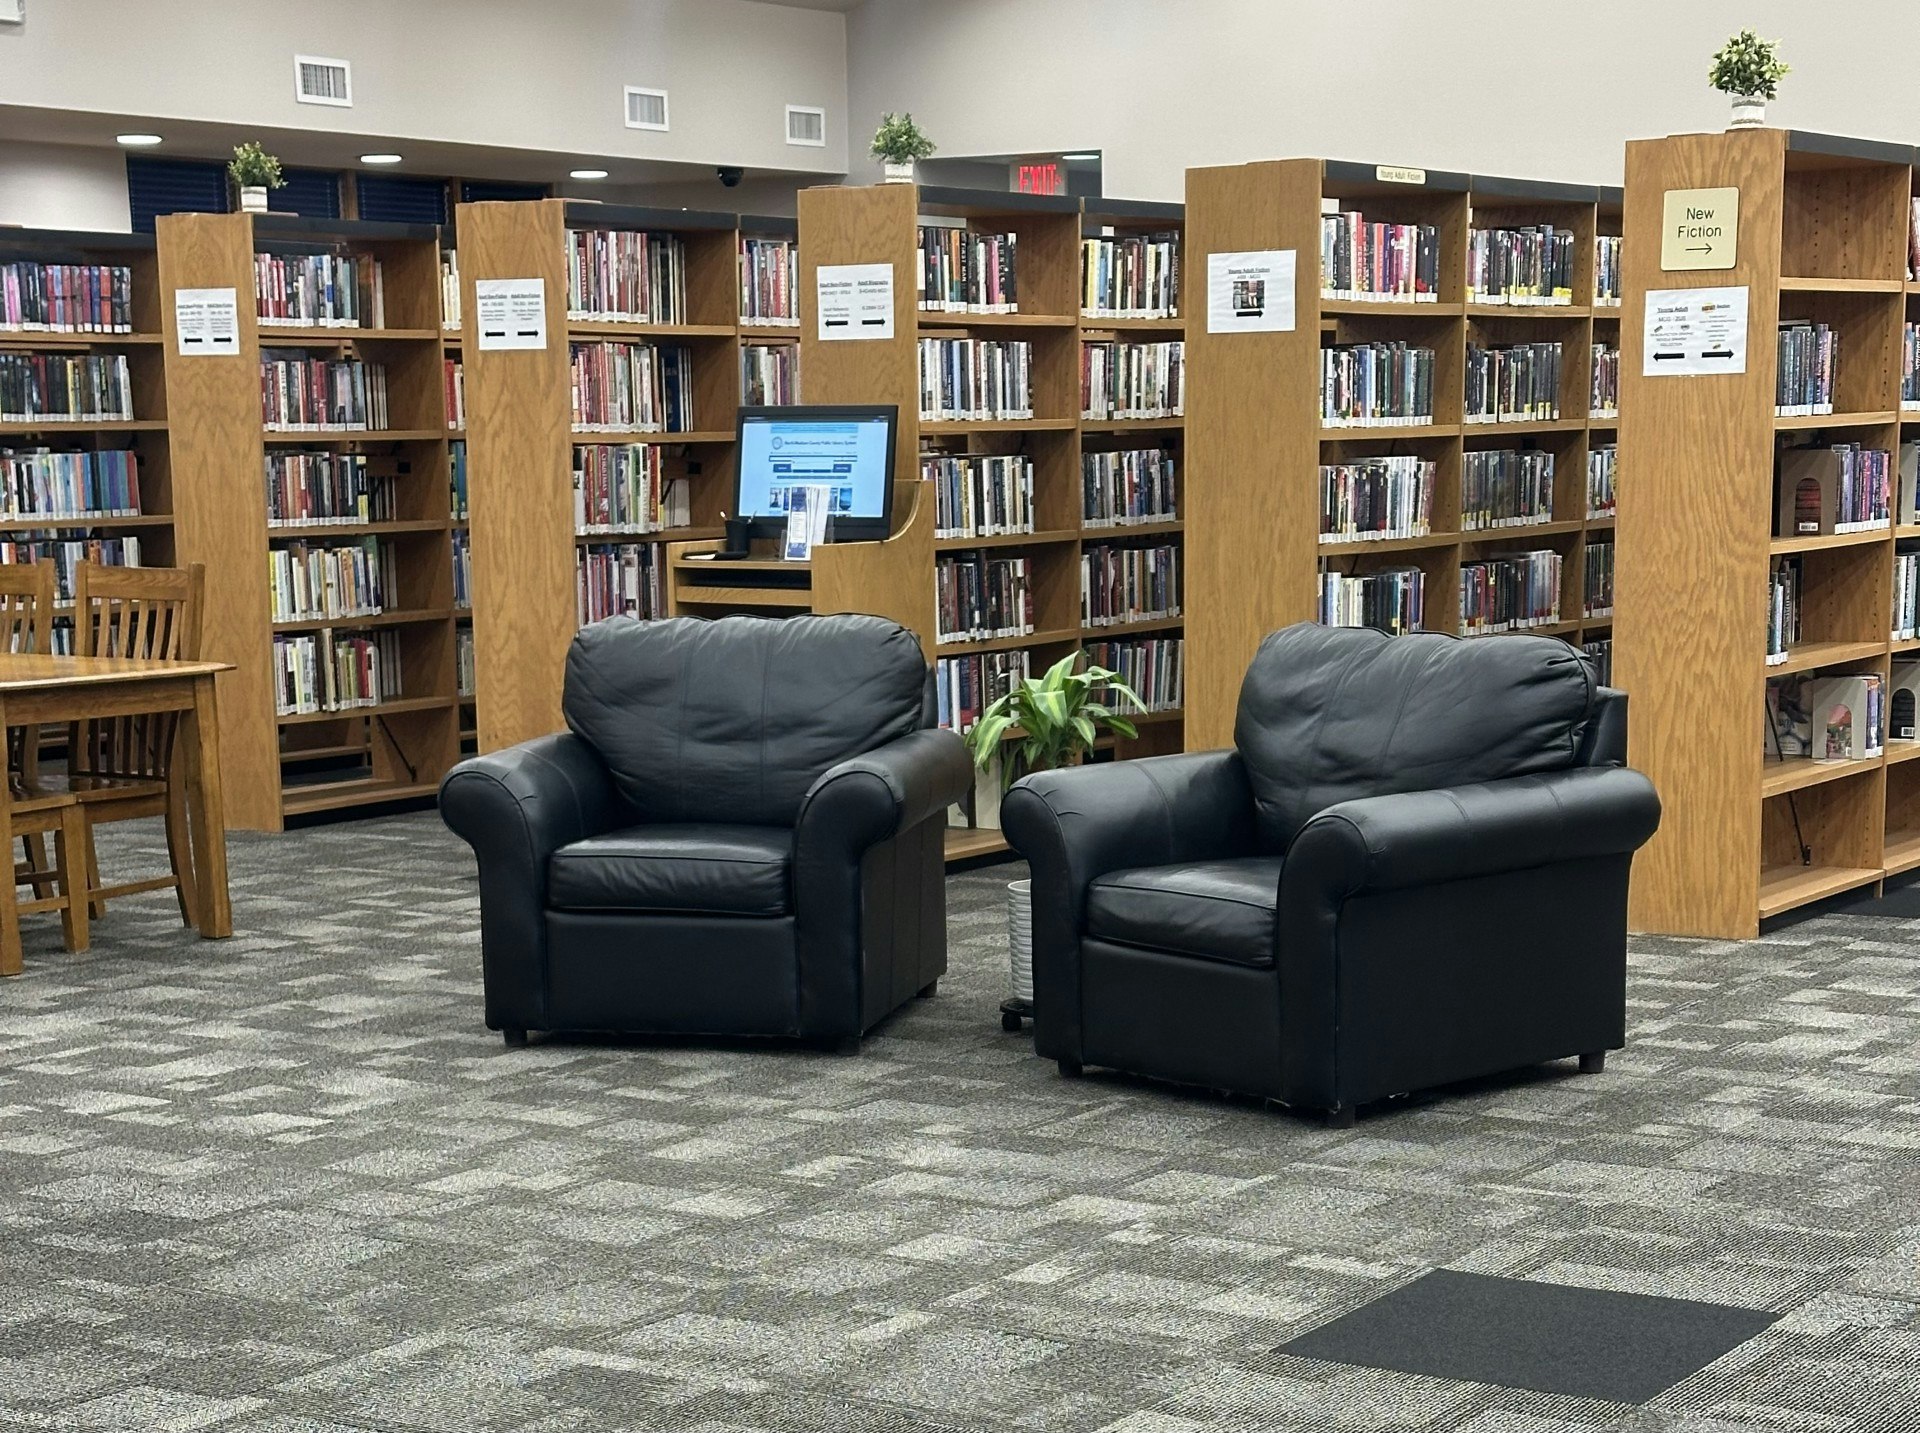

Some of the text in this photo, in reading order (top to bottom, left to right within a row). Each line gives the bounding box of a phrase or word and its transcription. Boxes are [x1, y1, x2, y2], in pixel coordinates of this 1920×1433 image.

[1019, 164, 1057, 195] EXIT
[1686, 207, 1714, 220] New
[1678, 225, 1722, 238] Fiction
